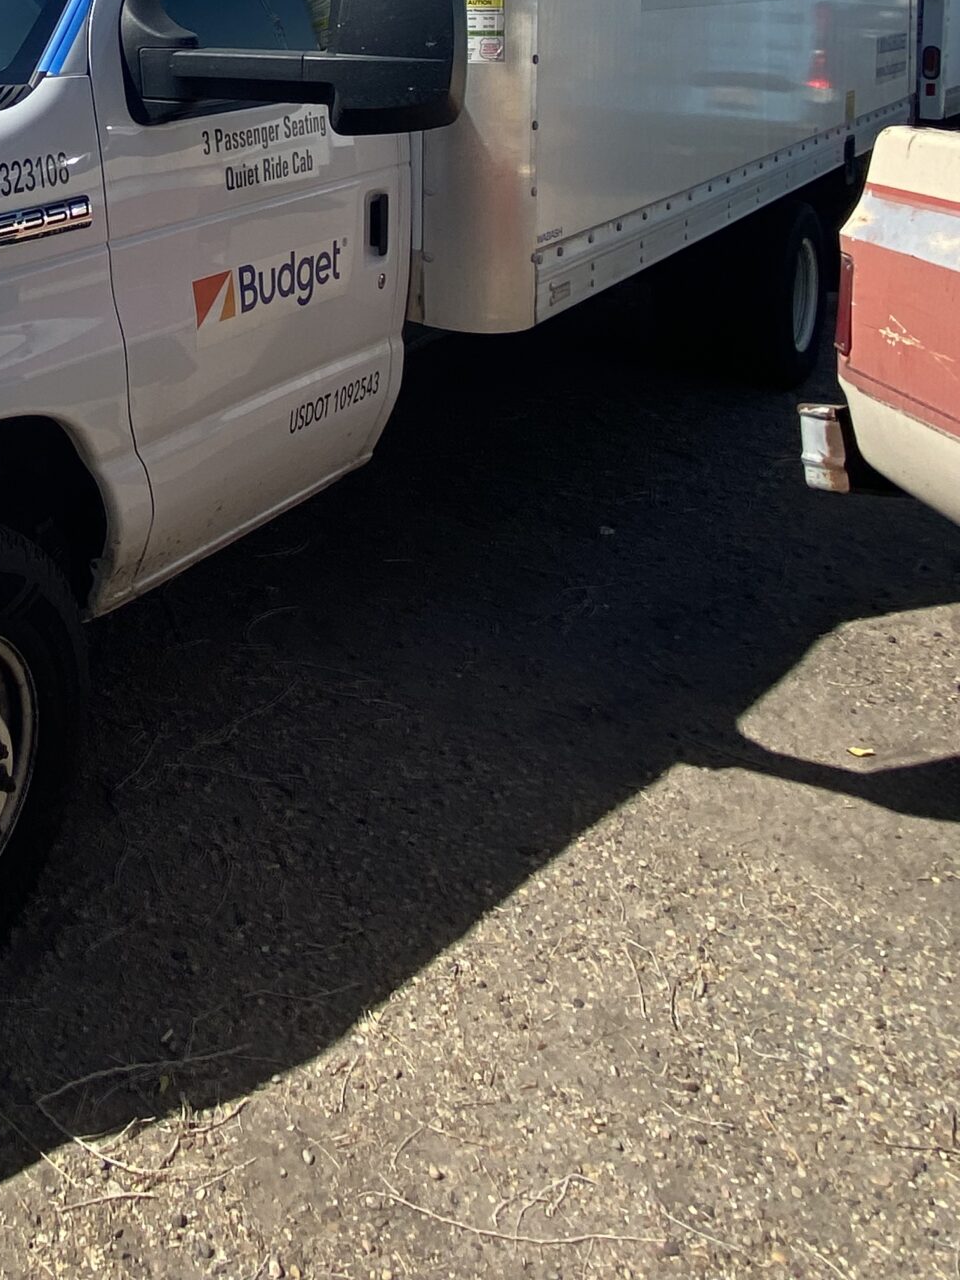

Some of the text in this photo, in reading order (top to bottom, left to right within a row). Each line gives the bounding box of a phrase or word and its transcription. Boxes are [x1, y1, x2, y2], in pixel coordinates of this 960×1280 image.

[202, 111, 327, 155] 3 Passenger Seating
[225, 149, 313, 191] Quiet Ride Cab
[239, 240, 340, 313] Budget
[289, 371, 380, 434] USDOT 1092543
